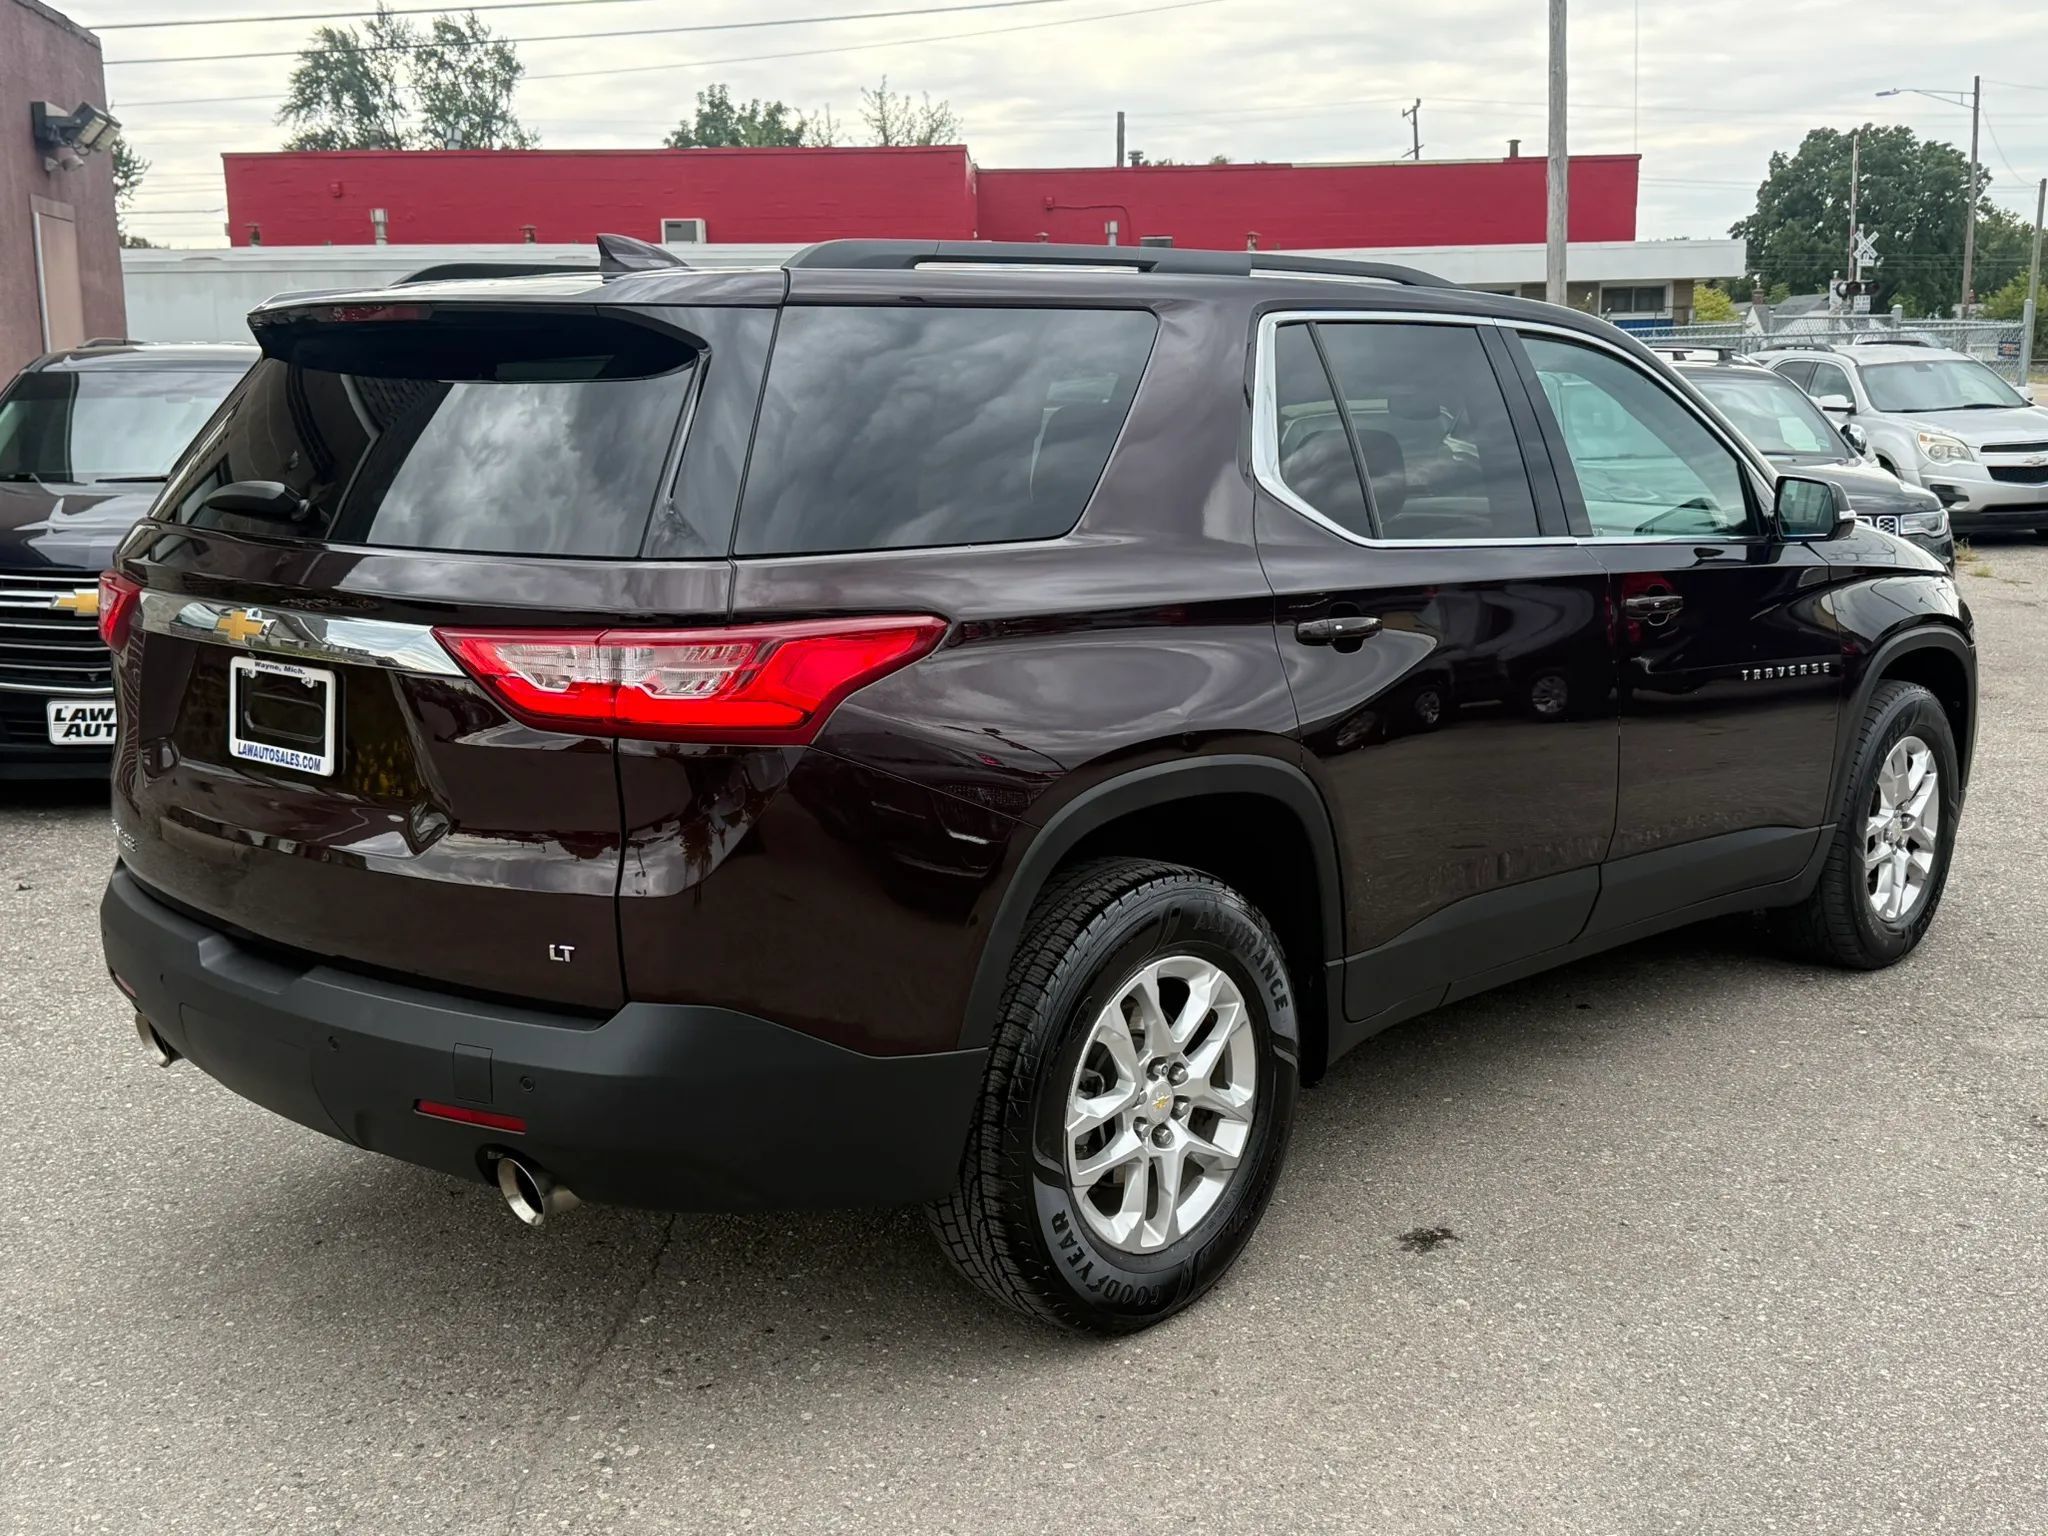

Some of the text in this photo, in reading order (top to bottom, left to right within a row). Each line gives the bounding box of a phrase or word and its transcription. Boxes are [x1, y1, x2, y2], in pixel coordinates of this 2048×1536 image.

[254, 661, 306, 675] Wayne, Mich.
[1741, 662, 1830, 681] TRAVERSE
[53, 707, 115, 722] LAW
[238, 741, 321, 772] LAWAUTOSALES.COM
[549, 944, 575, 963] LT
[1051, 1208, 1161, 1305] GOODYEAR
